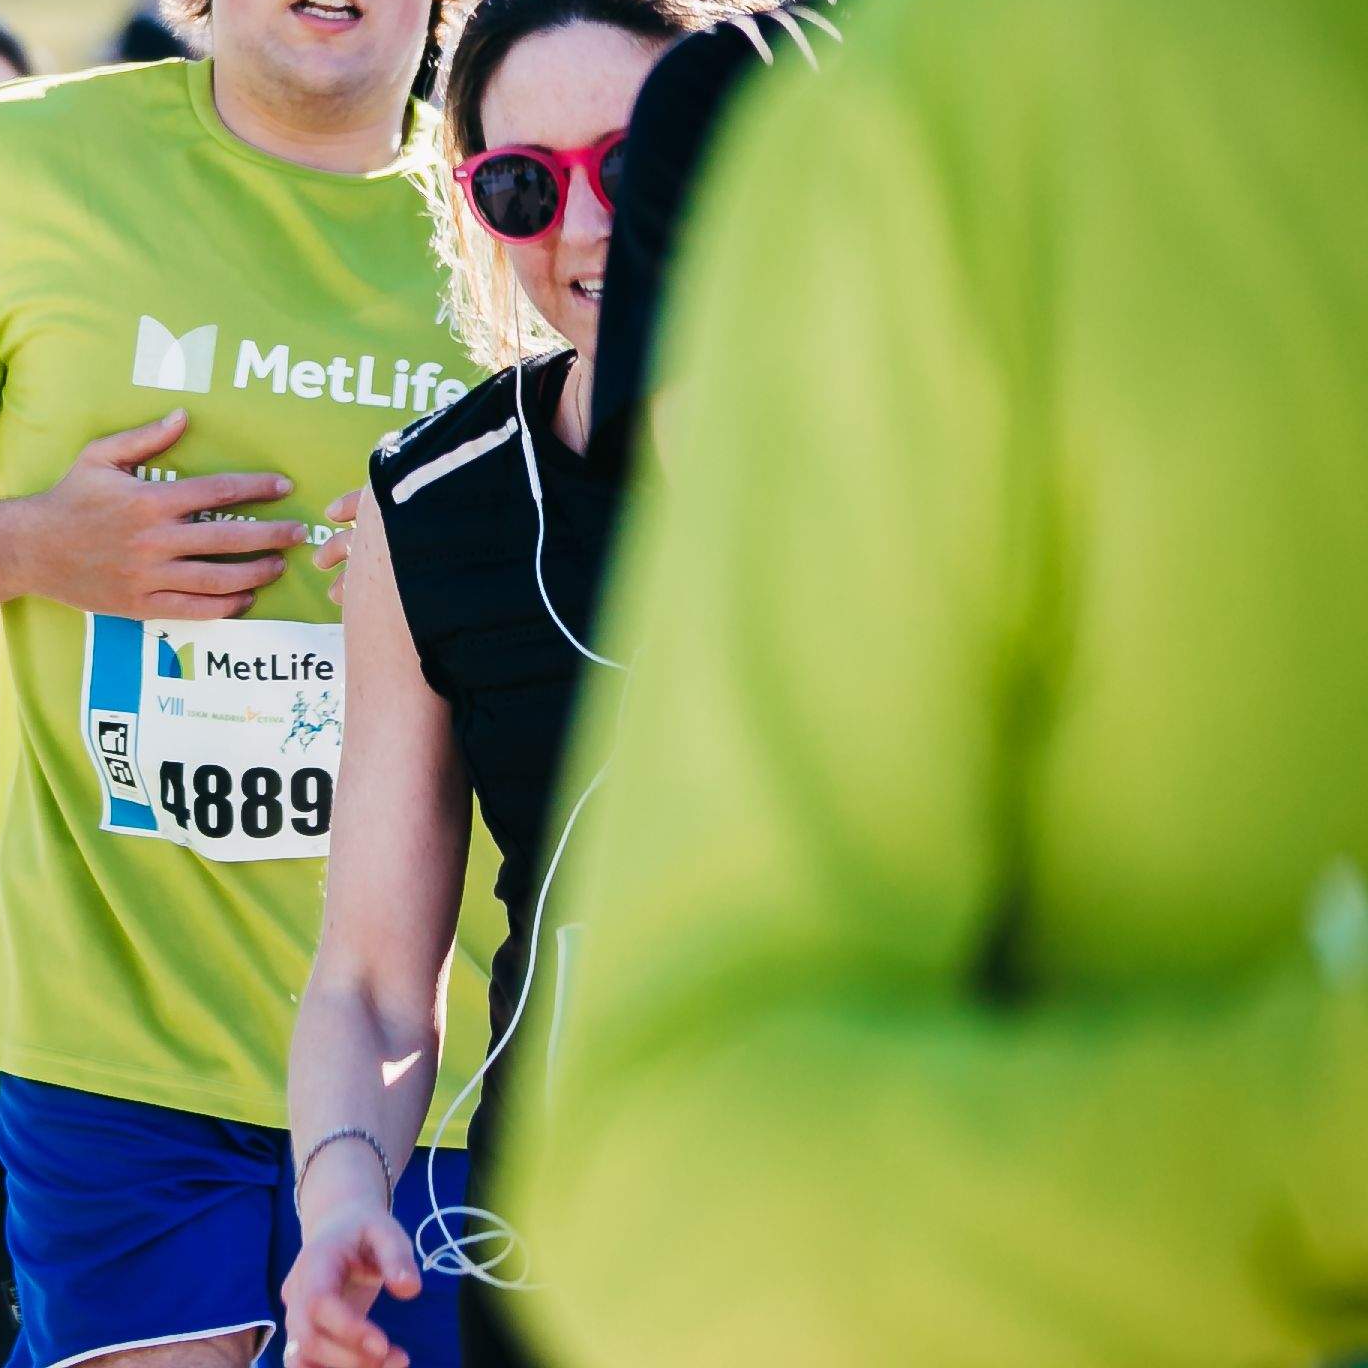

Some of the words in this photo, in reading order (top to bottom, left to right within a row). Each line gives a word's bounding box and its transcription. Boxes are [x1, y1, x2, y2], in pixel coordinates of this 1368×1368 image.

[233, 339, 469, 412] MetLife
[206, 650, 334, 681] MetLife
[156, 695, 184, 717] VIII
[159, 760, 334, 839] 4889
